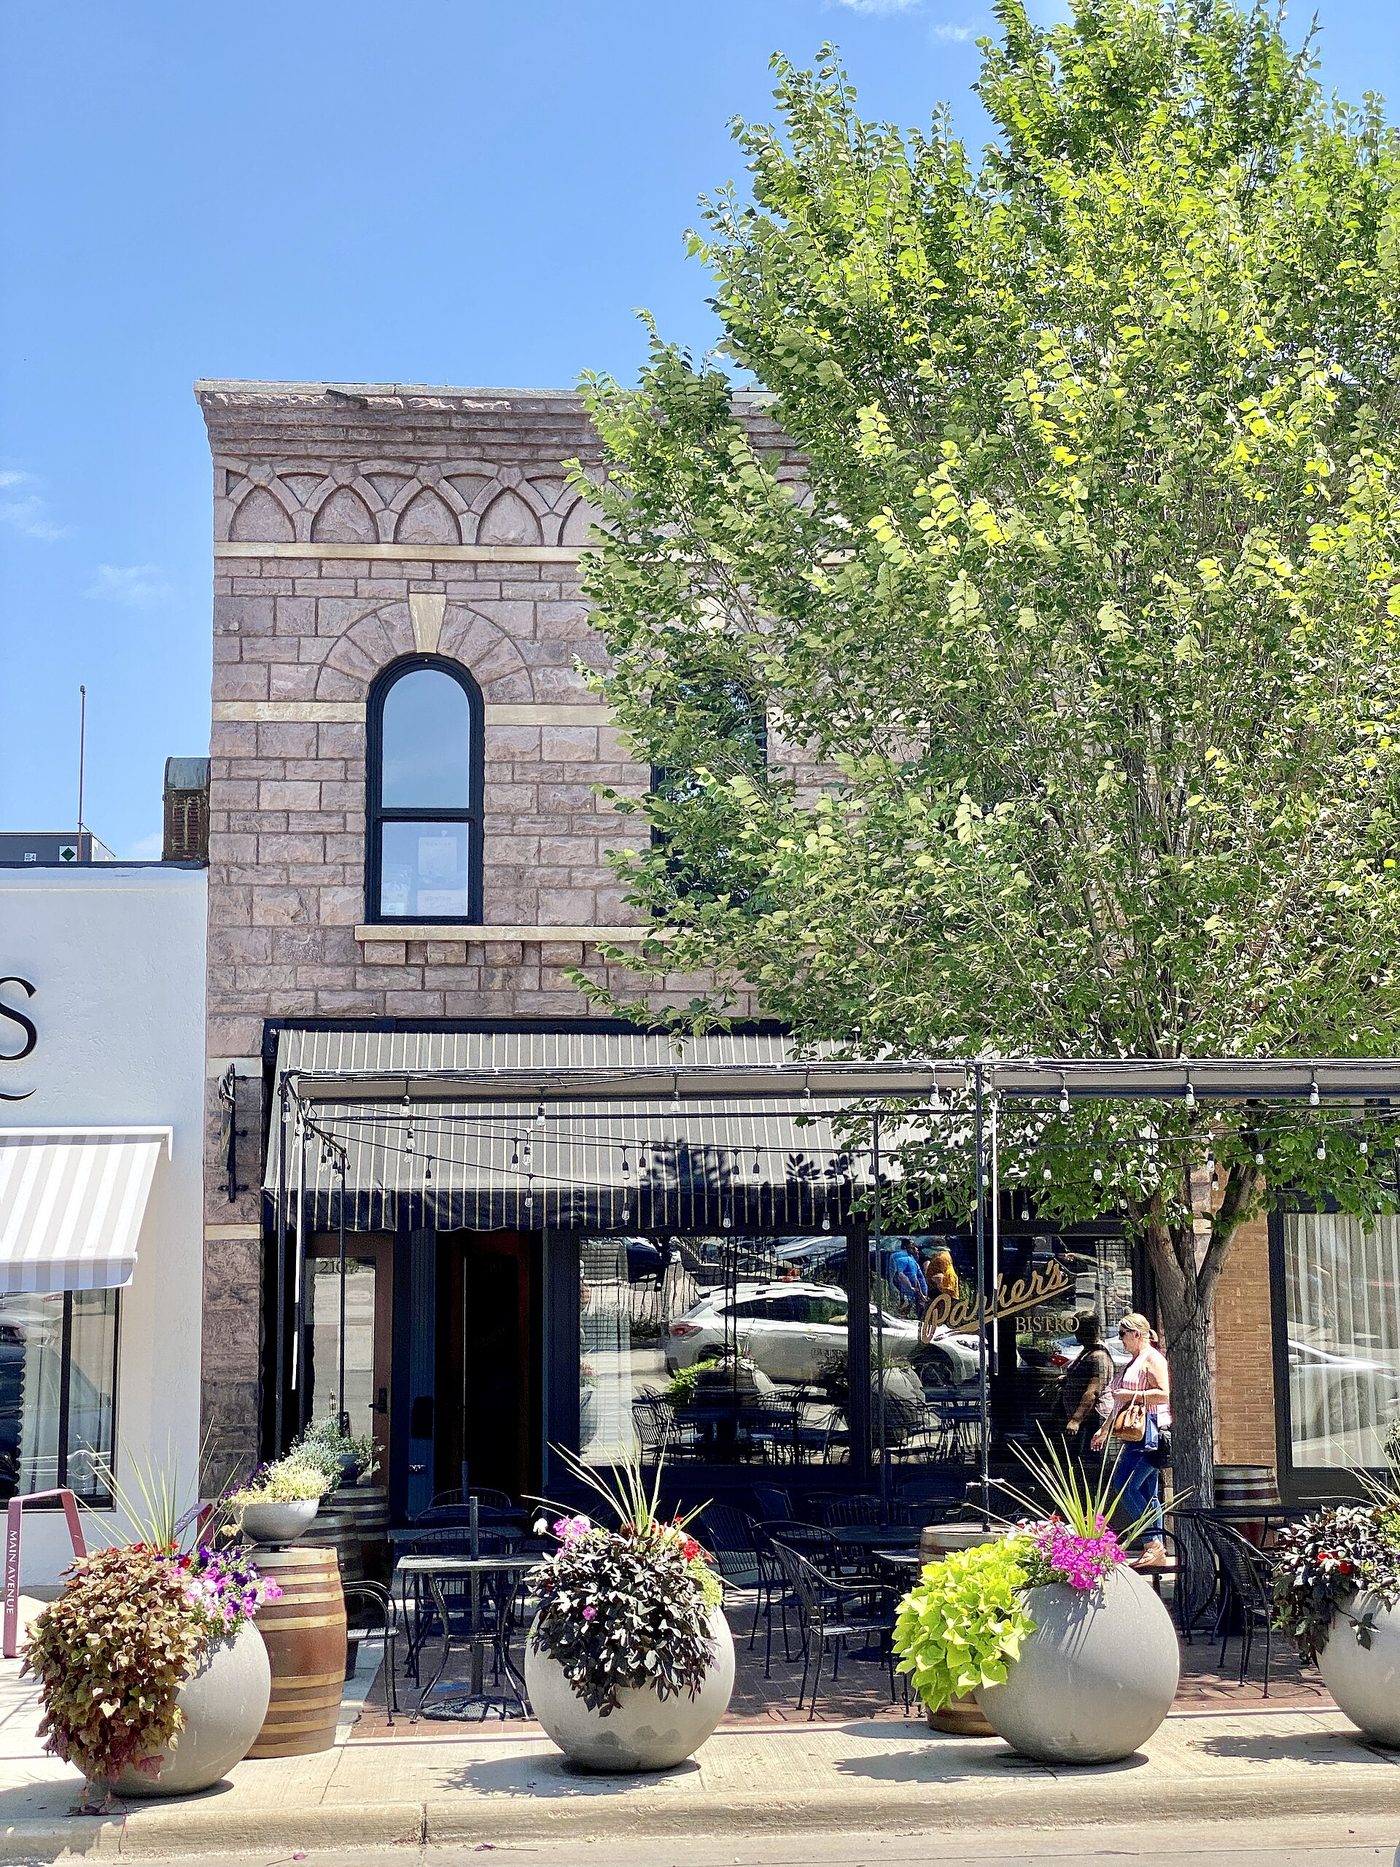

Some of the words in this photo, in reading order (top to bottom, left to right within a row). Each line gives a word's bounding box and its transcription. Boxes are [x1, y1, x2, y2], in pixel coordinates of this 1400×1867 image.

[1015, 1316, 1080, 1333] BISTRO
[7, 1530, 18, 1562] MAIN
[6, 1568, 16, 1614] AVENUE
